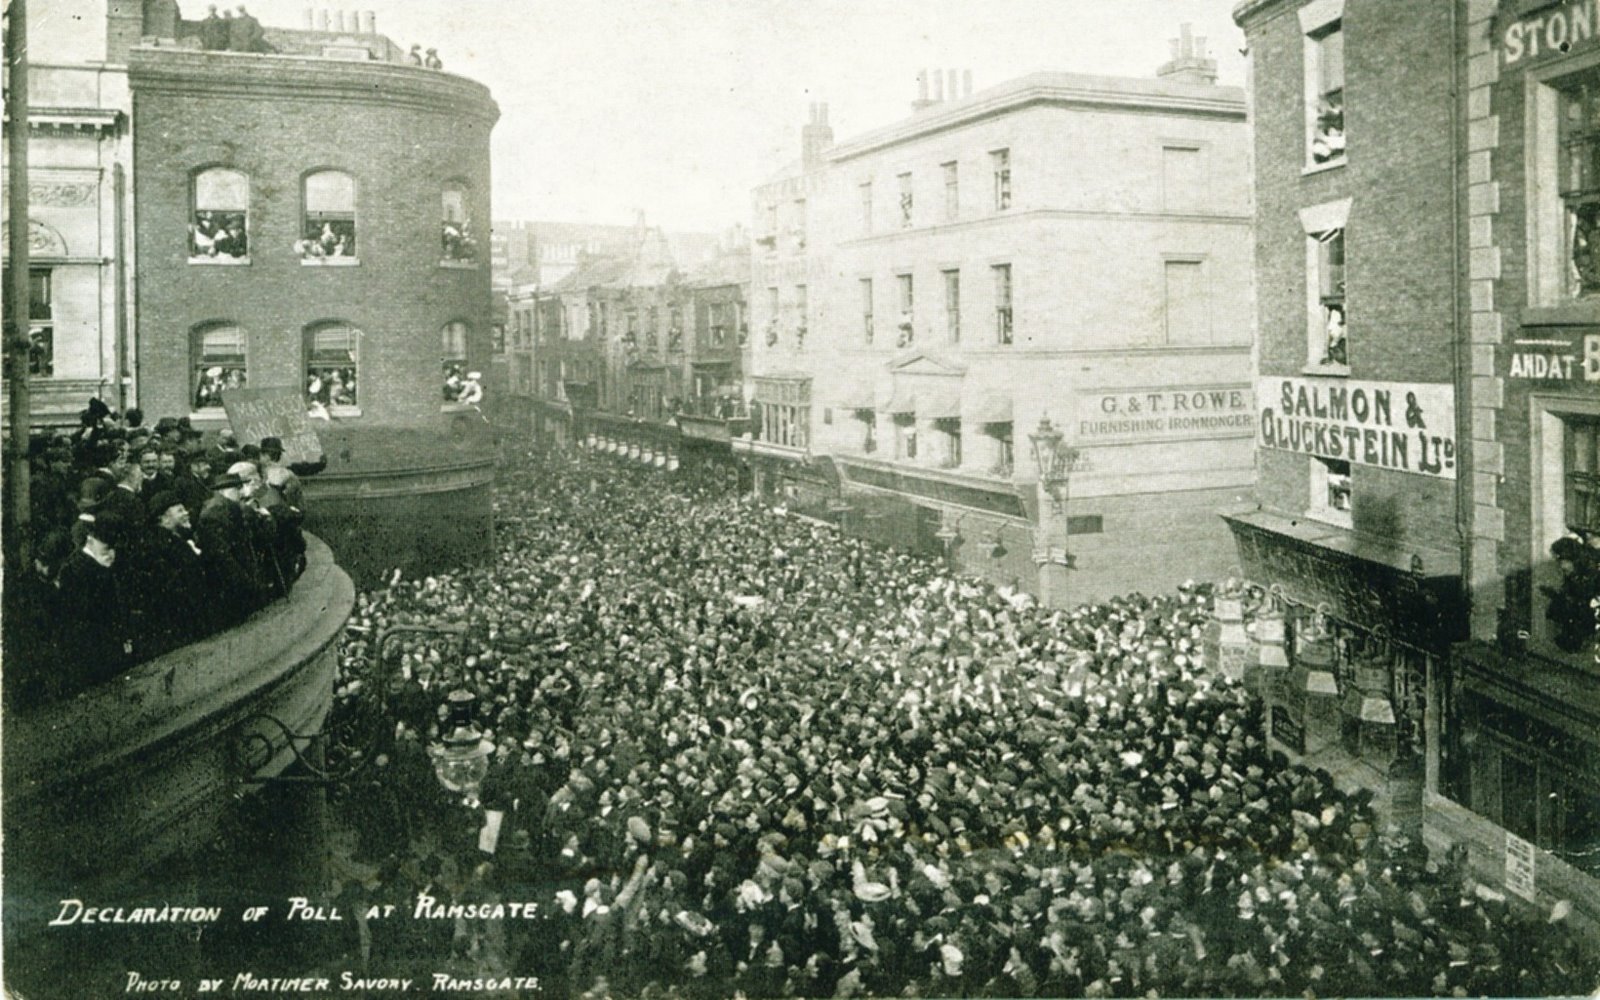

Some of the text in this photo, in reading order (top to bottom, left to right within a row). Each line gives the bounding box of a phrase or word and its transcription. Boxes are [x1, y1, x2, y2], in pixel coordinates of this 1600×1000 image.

[1505, 0, 1600, 63] STON
[1080, 418, 1165, 435] FURNISHING
[1100, 396, 1123, 414] G.
[1128, 396, 1141, 413] &
[1147, 394, 1166, 412] T.
[1281, 381, 1426, 429] SALMON &
[1261, 407, 1409, 470] GLUCKSTEIN
